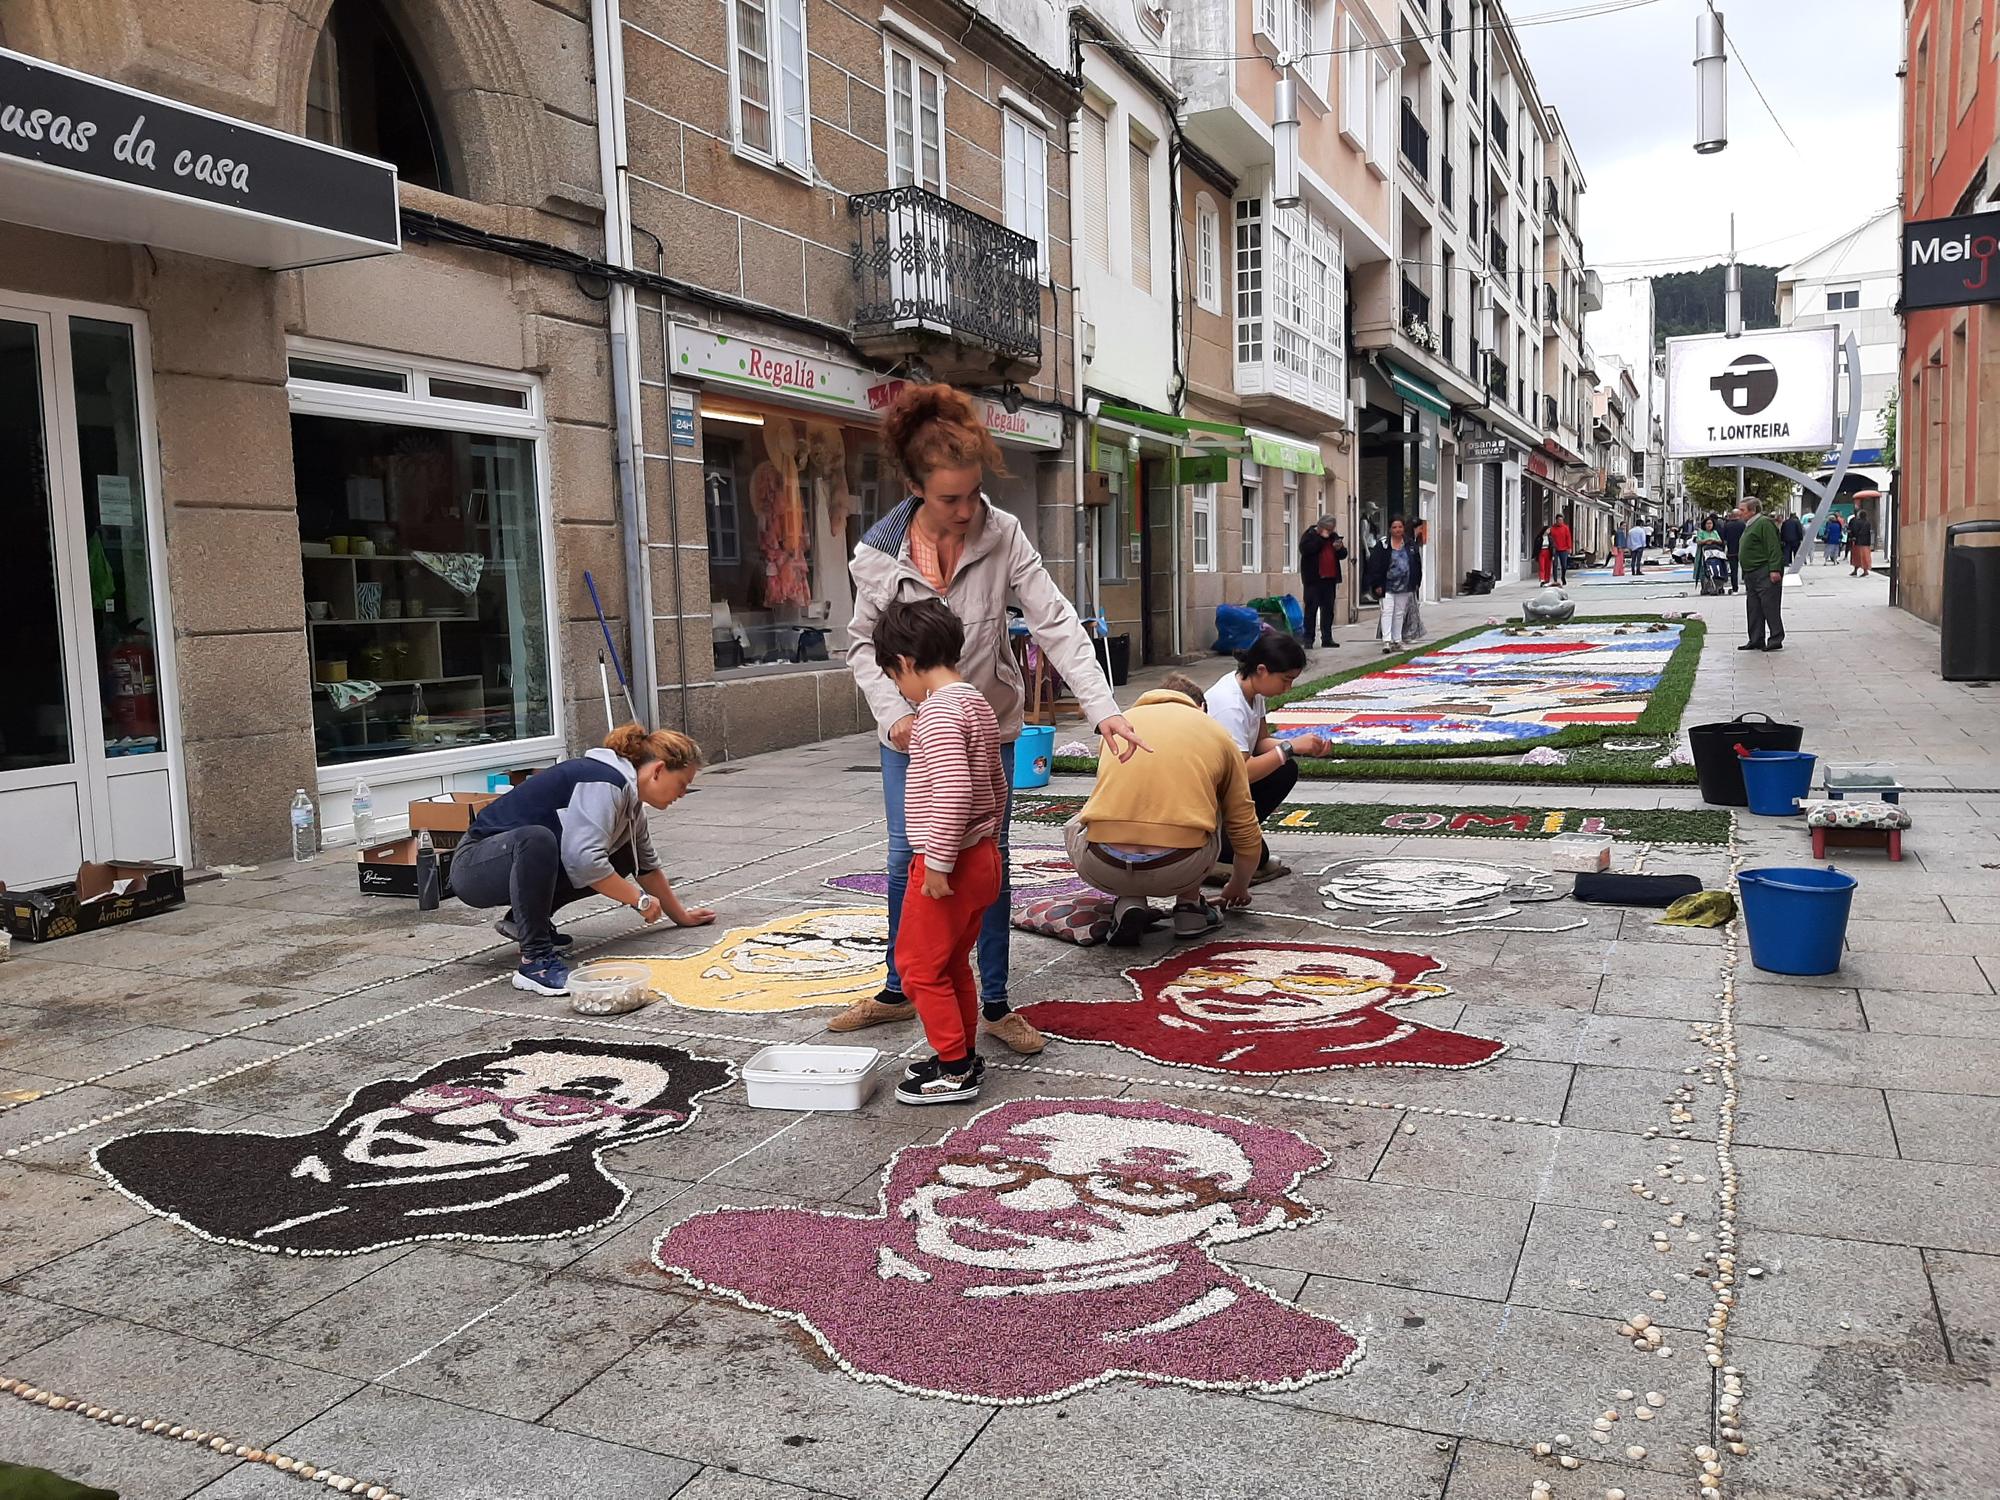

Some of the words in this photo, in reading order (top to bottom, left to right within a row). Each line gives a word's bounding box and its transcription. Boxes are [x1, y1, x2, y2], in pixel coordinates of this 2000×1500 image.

[0, 103, 97, 152] usas
[113, 115, 156, 170] da
[173, 150, 249, 193] casa
[1911, 233, 2000, 290] Meig
[1707, 426, 1718, 442] T.
[1720, 422, 1791, 441] LONTREIRA
